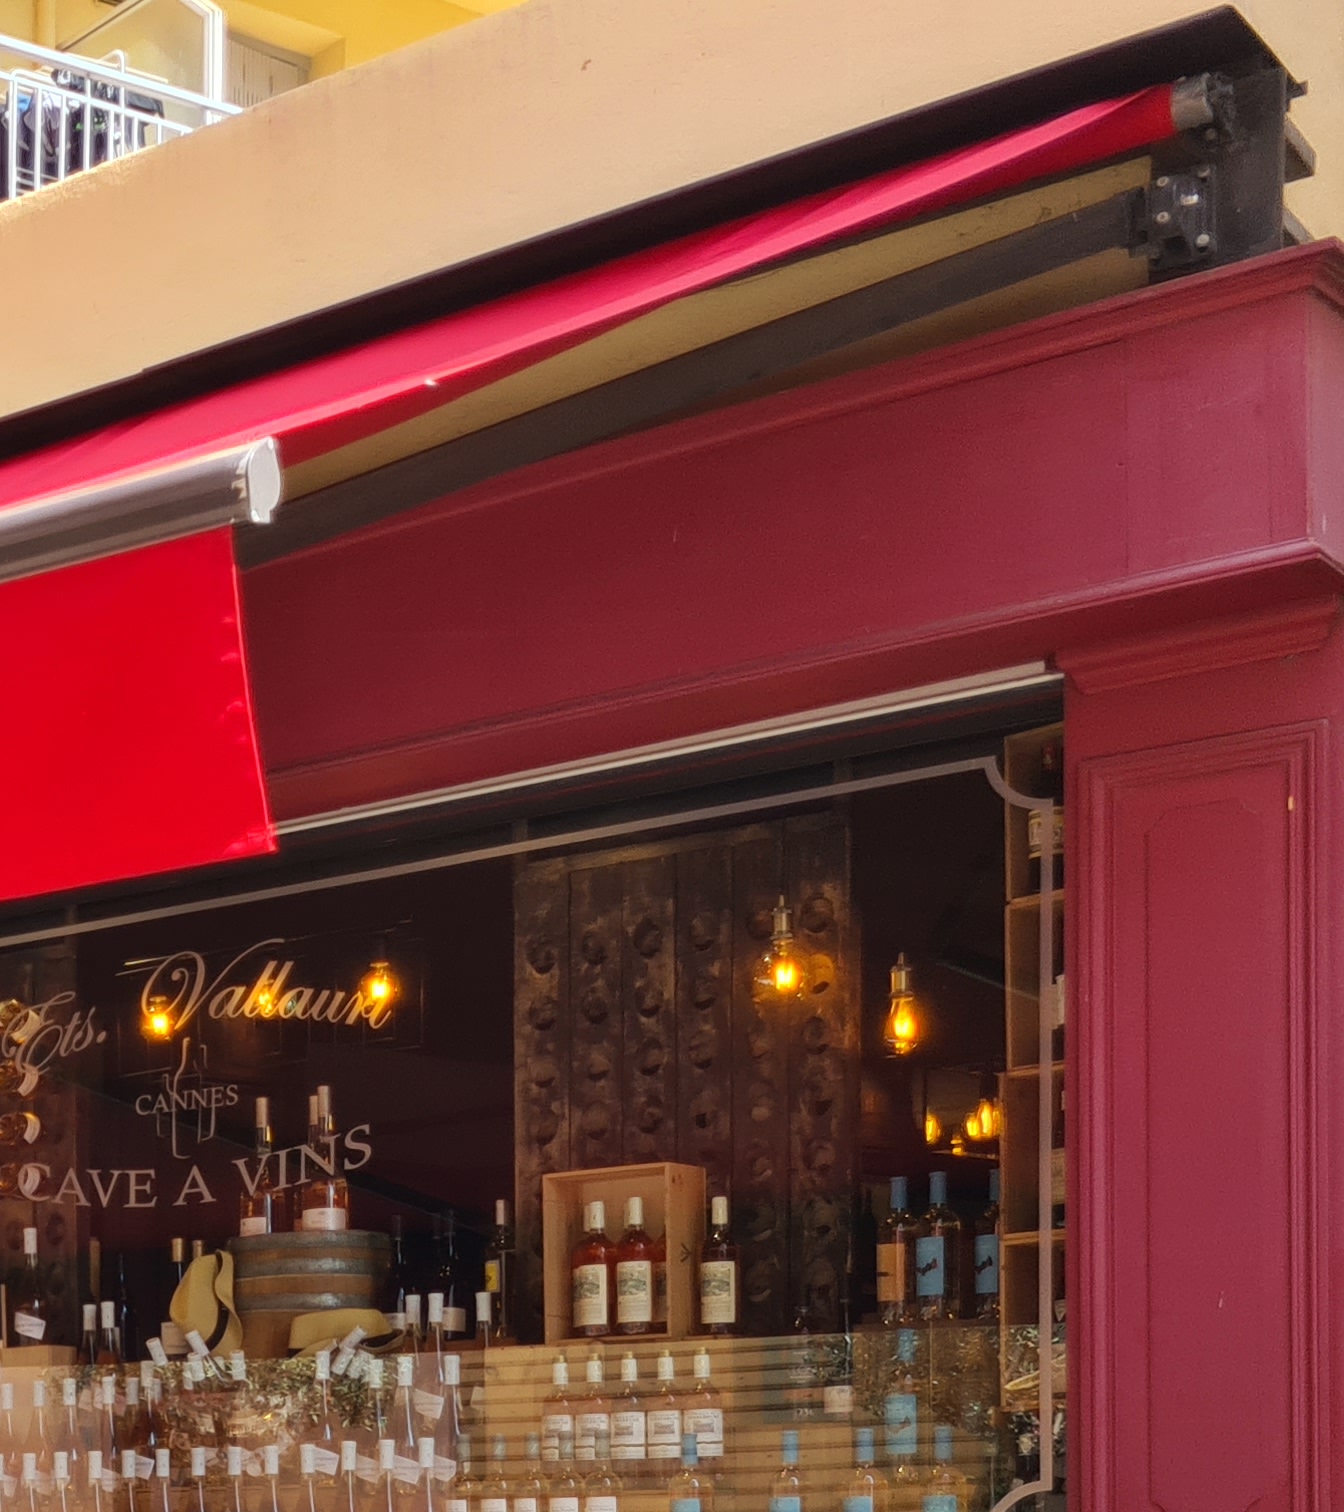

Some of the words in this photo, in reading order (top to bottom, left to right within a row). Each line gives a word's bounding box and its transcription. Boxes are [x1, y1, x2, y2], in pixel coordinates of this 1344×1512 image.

[135, 1084, 240, 1117] CANNES
[18, 1162, 158, 1209] CAVE
[172, 1165, 217, 1207] A
[231, 1124, 373, 1199] VINS
